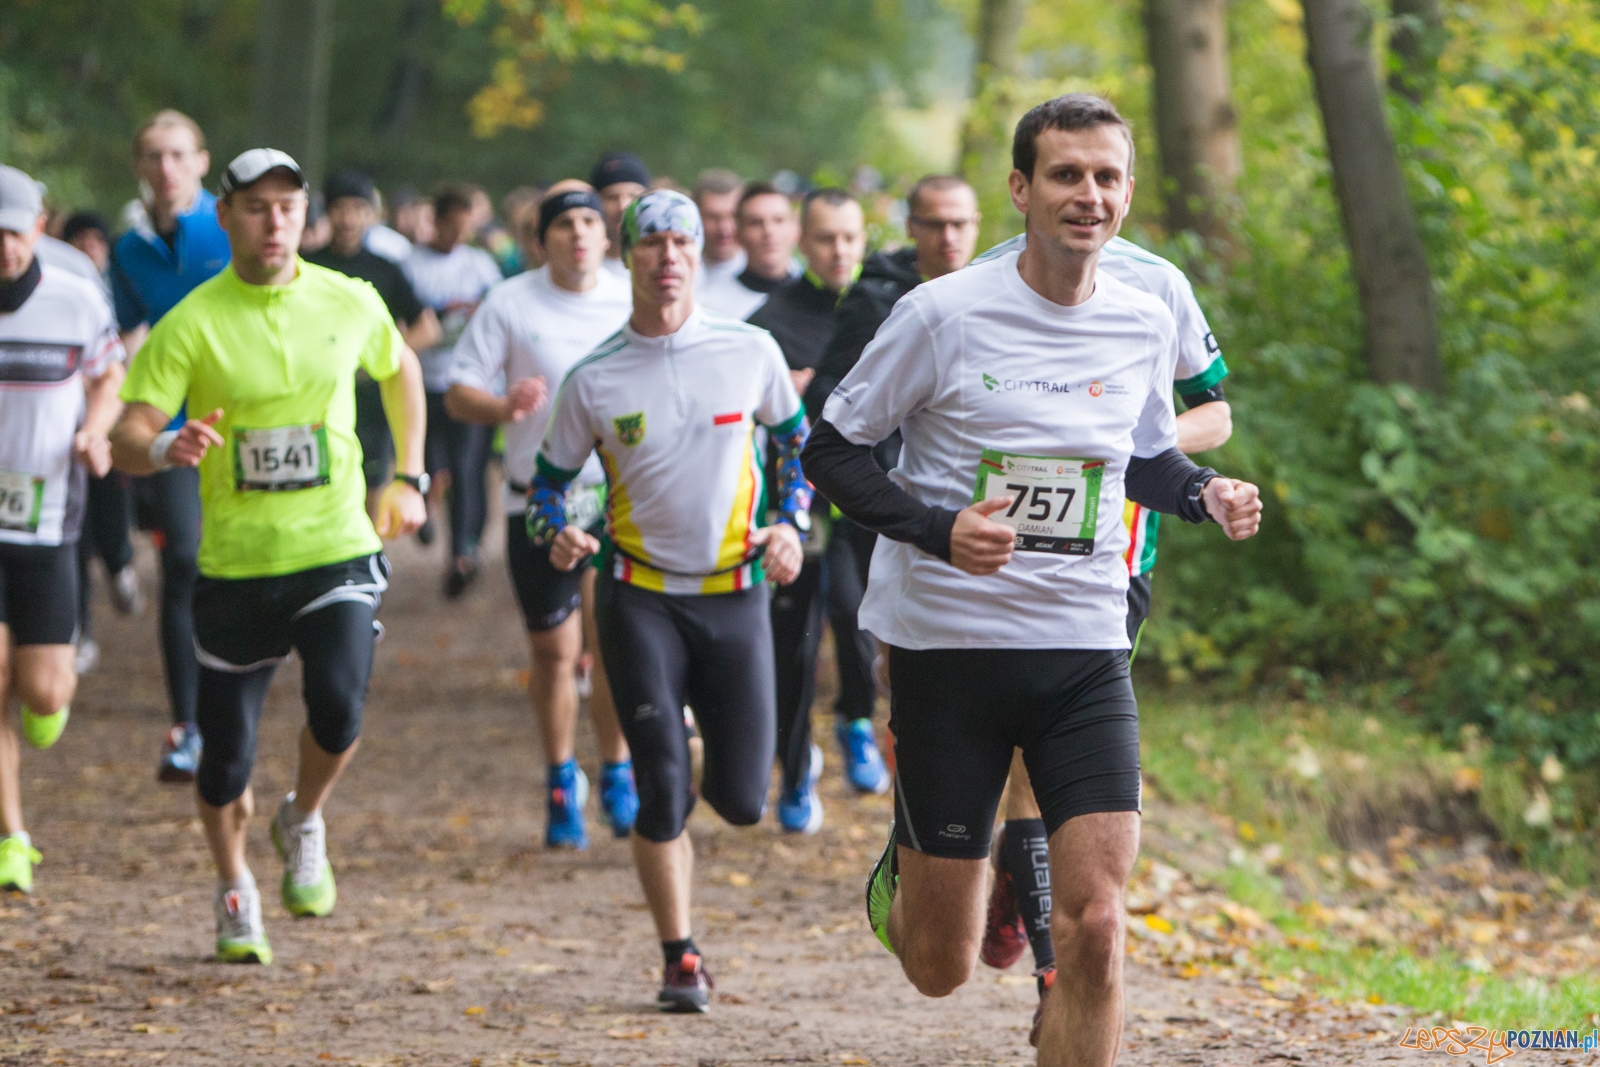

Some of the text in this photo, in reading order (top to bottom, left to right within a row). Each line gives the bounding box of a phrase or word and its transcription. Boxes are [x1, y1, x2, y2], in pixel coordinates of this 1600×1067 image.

[250, 443, 313, 471] 1541
[1005, 483, 1076, 523] 757
[1017, 523, 1054, 535] DAMIAN
